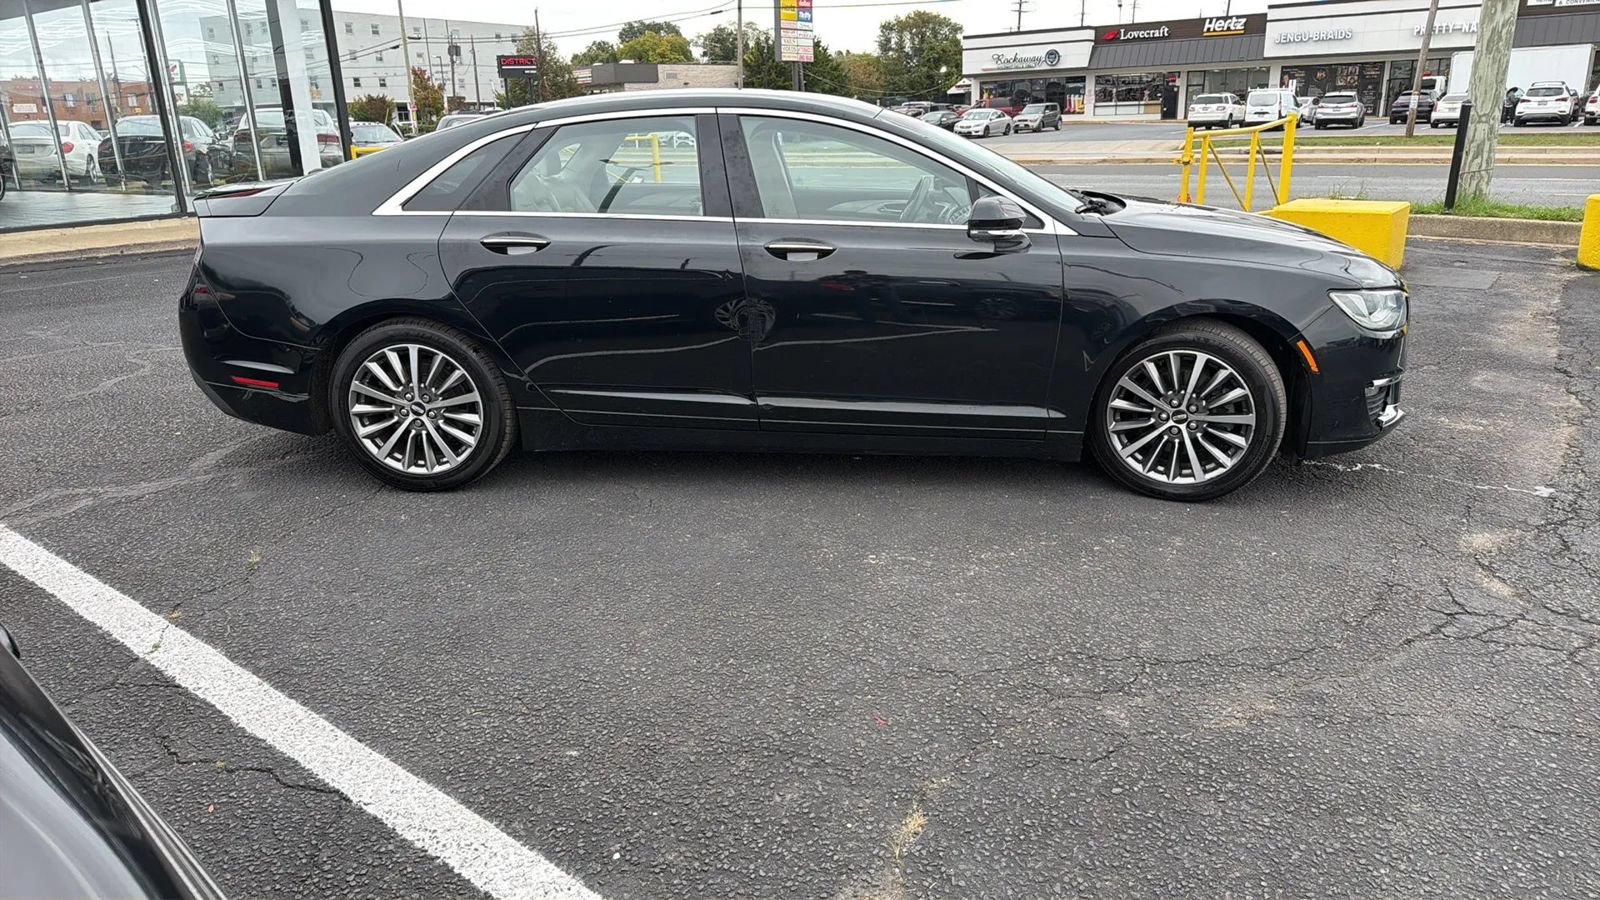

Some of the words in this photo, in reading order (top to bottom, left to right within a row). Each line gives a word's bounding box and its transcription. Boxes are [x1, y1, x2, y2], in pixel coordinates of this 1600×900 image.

[1202, 17, 1247, 32] Hertz
[1120, 26, 1169, 40] Lovecraft
[1275, 29, 1353, 44] JENGU-BRAIDS
[991, 52, 1043, 66] Rockaway
